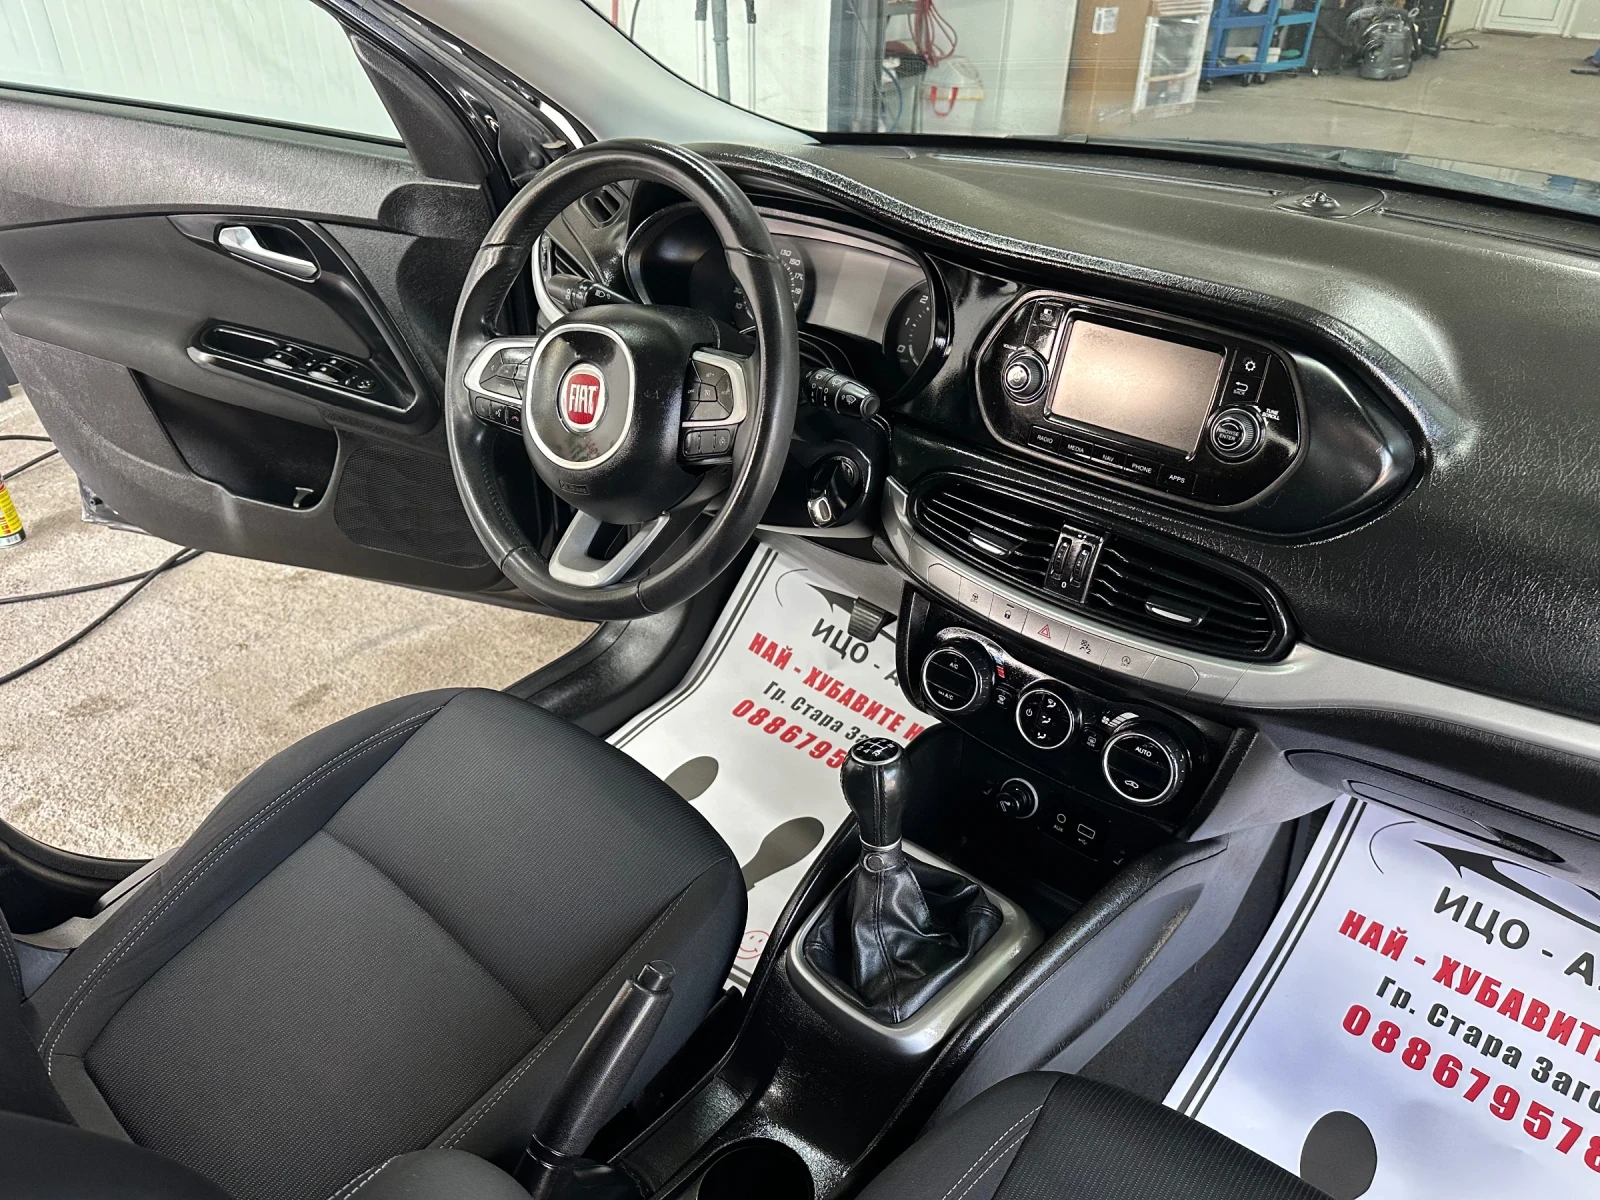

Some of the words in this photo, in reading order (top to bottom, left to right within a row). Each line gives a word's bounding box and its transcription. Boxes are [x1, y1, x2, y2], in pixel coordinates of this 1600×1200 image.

[780, 249, 791, 257] 130
[789, 258, 801, 266] 150
[919, 294, 929, 304] 2
[568, 383, 599, 415] FIAT
[1036, 434, 1054, 444] RADIO
[1219, 433, 1236, 441] ENTER
[1067, 443, 1085, 454] MEDIA
[1102, 454, 1115, 463] NAV
[1131, 462, 1153, 474] PHONE
[1168, 474, 1186, 484] APPS
[811, 617, 869, 664] ИЦО
[949, 662, 959, 670] A/C
[748, 632, 794, 671] НАЙ
[802, 666, 906, 733] ХУБАВИТЕ
[763, 680, 786, 704] Гр.
[790, 694, 844, 733] Стара
[732, 699, 848, 769] 0886795
[1135, 746, 1152, 758] AUTO
[1053, 824, 1064, 833] AUX
[1434, 886, 1530, 950] ИЦО
[1563, 951, 1600, 991] А
[1338, 909, 1408, 961] НАЙ
[1433, 955, 1600, 1063] ХУБАВИТ
[1376, 975, 1416, 1015] Гр.
[1427, 1003, 1523, 1070] Стара
